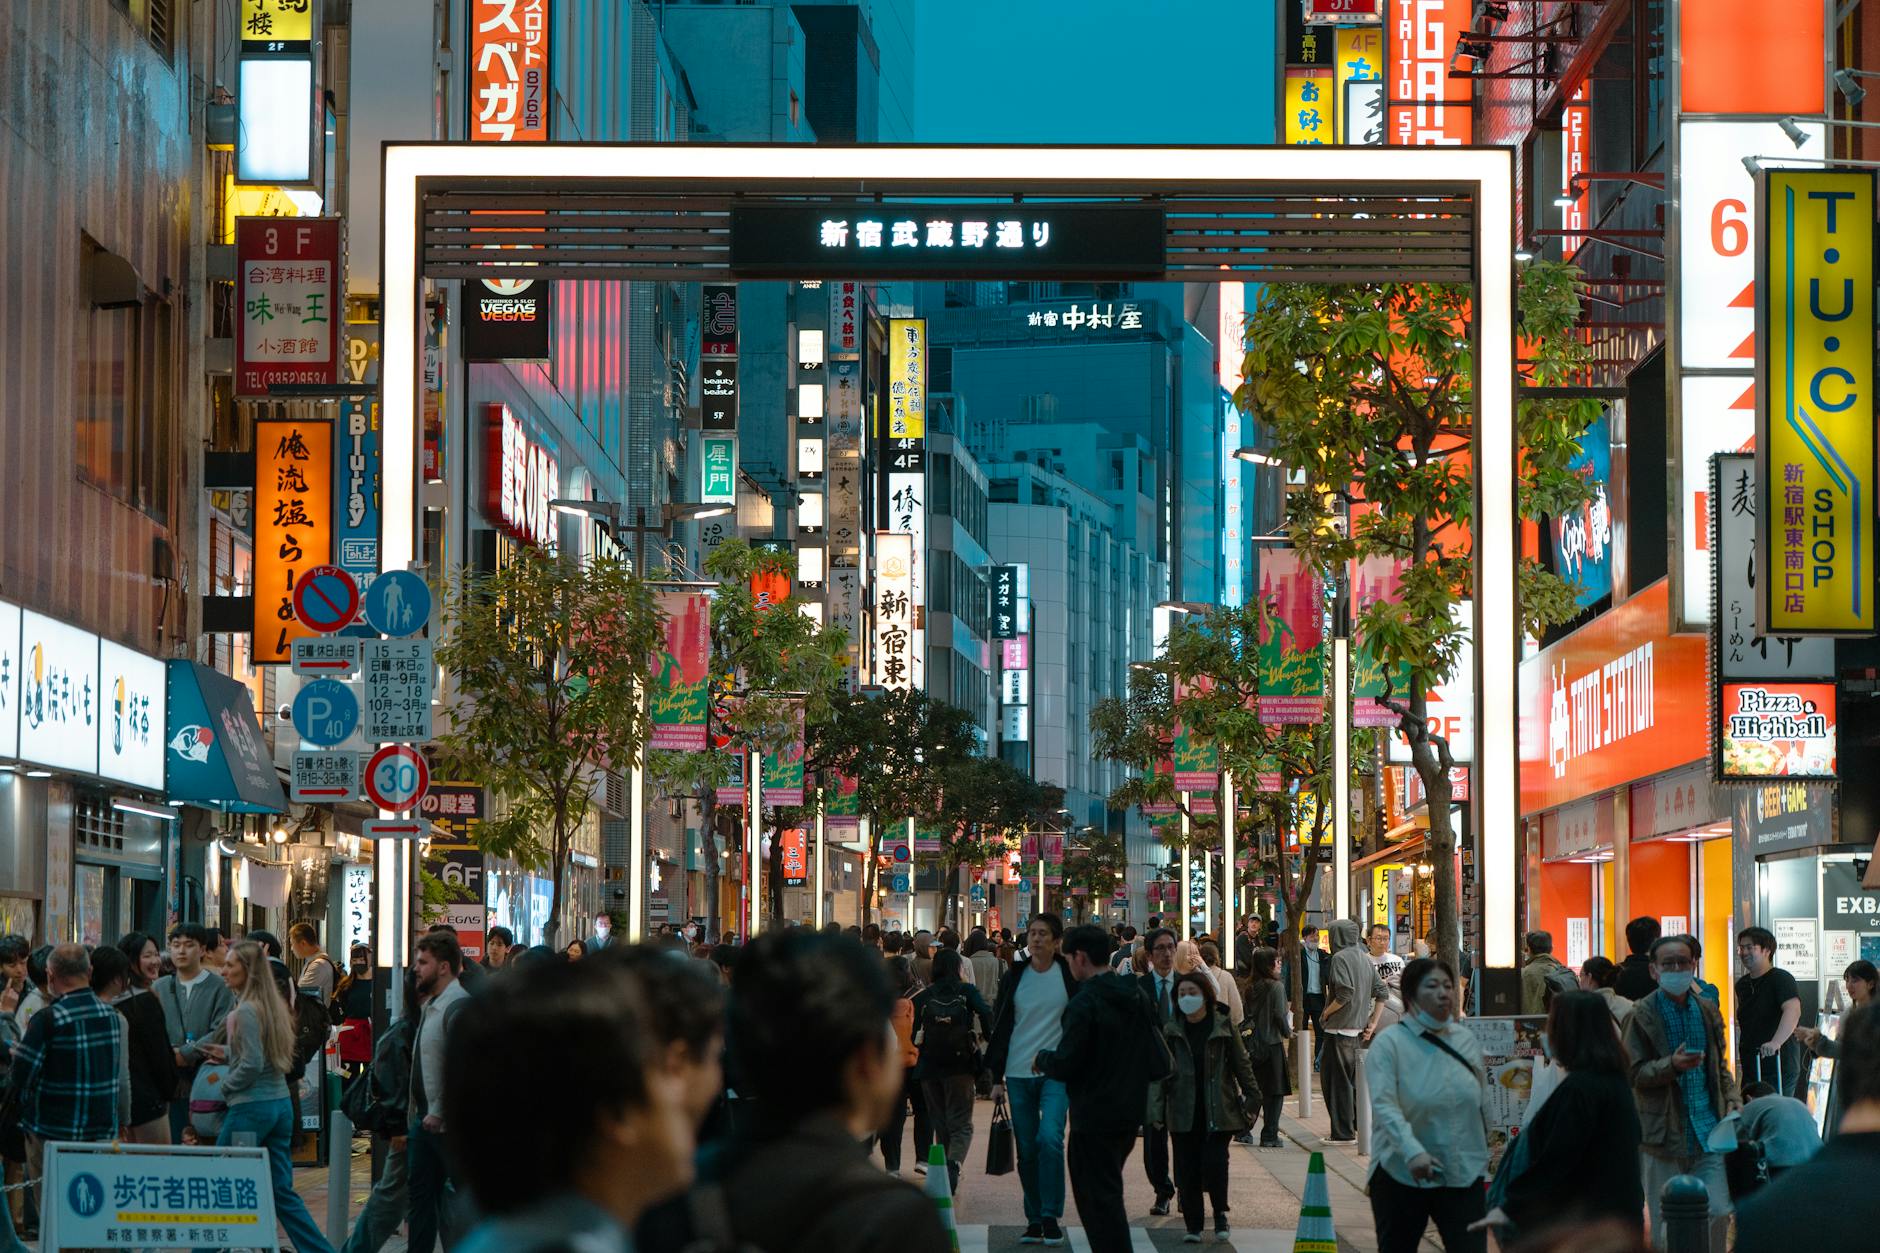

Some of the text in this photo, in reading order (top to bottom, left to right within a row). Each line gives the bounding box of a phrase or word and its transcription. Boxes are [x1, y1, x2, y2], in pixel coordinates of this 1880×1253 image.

[268, 43, 285, 52] 2F
[1351, 34, 1377, 53] 4F
[1399, 0, 1412, 99] TAITO
[525, 70, 541, 127] 876台
[1296, 80, 1323, 144] お好
[820, 220, 1051, 249] 新宿武蔵野通り
[249, 267, 327, 284] 台湾料理
[481, 303, 536, 313] VEGAS
[710, 292, 735, 335] HUB
[1028, 303, 1143, 331] 新宿 中村屋
[256, 337, 318, 354] 小酒館
[704, 378, 734, 386] beauty
[713, 412, 725, 420] 5F
[897, 438, 916, 450] 4F
[894, 454, 920, 469] 4F
[1783, 463, 1805, 613] 新宿駅東南口店
[1811, 488, 1835, 588] SHOP
[998, 572, 1010, 607] メガネ
[880, 589, 909, 685] 新宿東
[1729, 600, 1744, 663] らーめん
[46, 664, 92, 727] 焼きいも
[1570, 641, 1654, 759] TAITO STATION
[1740, 690, 1802, 713] Pizza
[129, 690, 150, 747] 抹茶
[307, 697, 332, 738] P
[325, 721, 343, 738] 40
[1731, 716, 1826, 741] Highball
[380, 764, 415, 793] 30
[441, 862, 481, 888] 6F
[113, 1175, 259, 1210] 歩行者用道路
